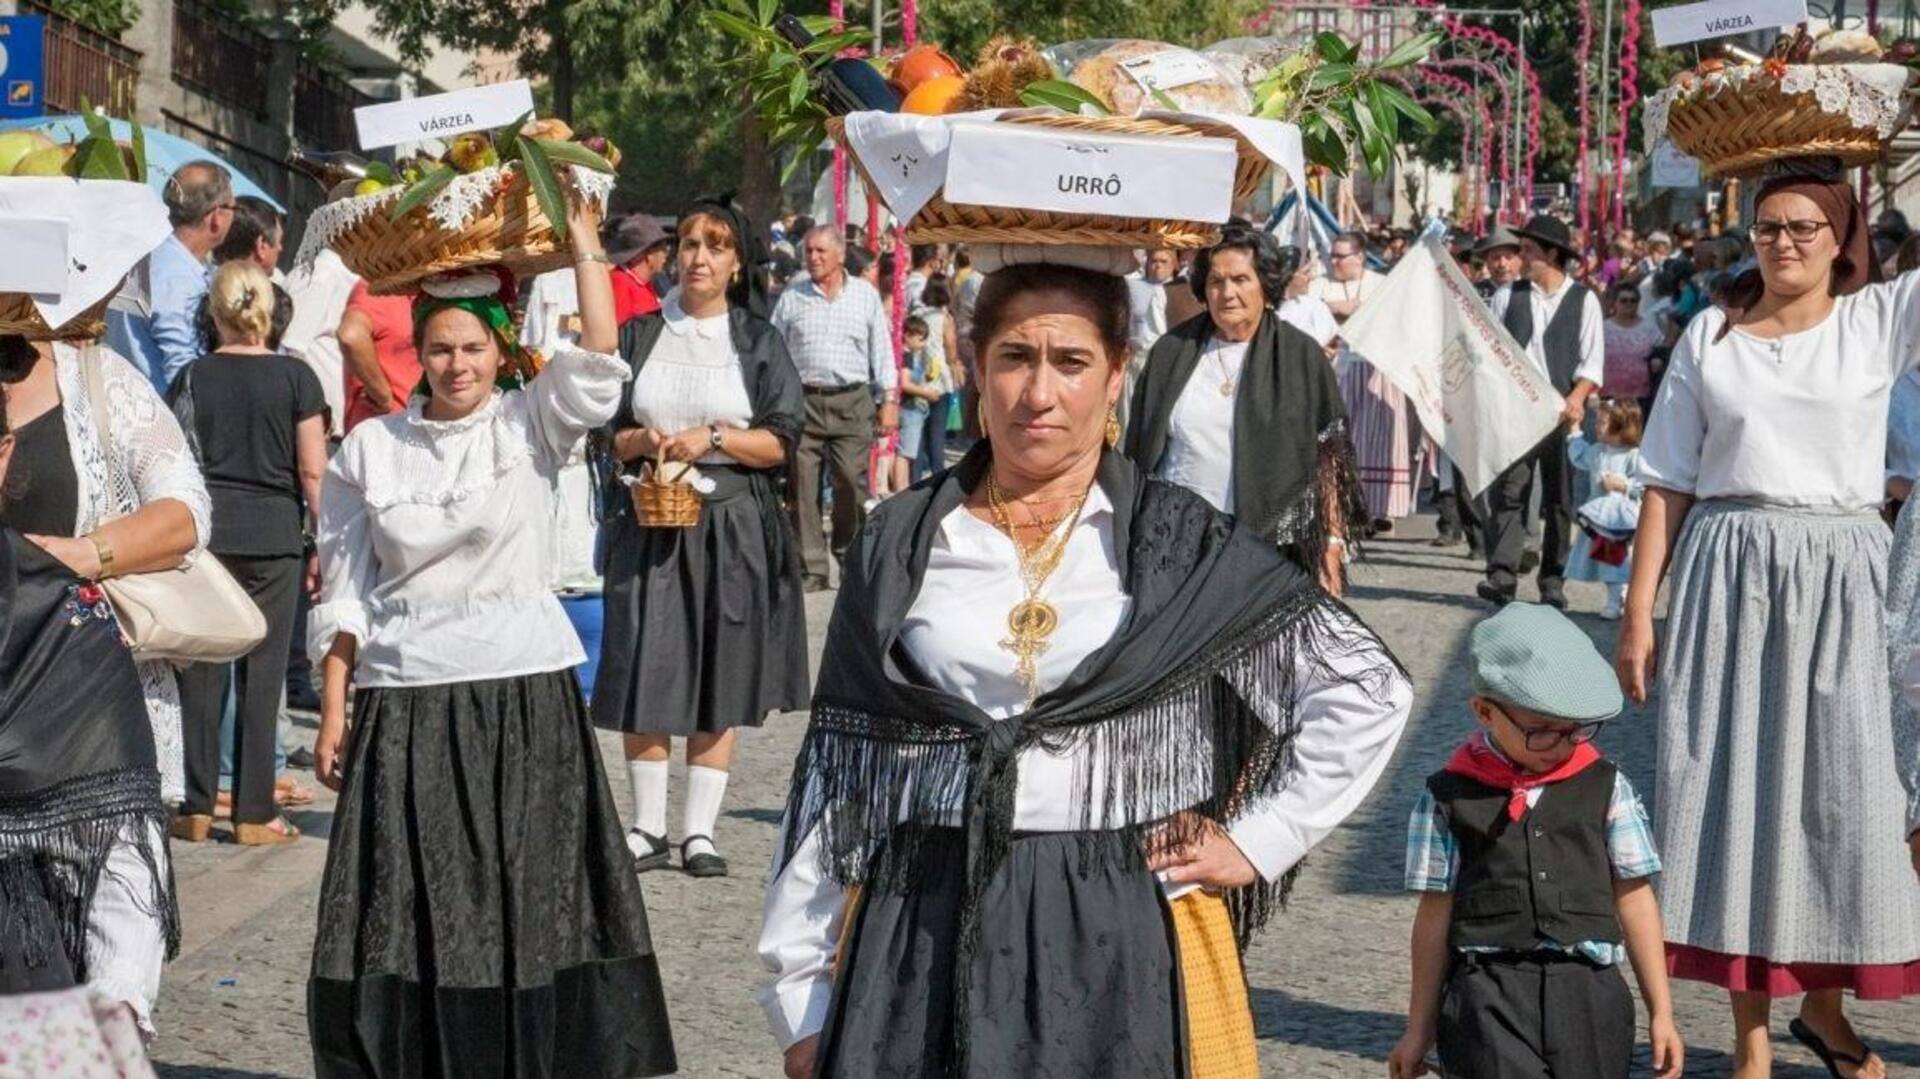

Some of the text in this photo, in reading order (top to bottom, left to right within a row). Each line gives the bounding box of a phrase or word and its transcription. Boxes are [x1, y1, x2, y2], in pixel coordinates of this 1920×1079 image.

[1704, 14, 1753, 32] VÁRZEA
[419, 113, 474, 132] VÁRZEA
[1058, 173, 1121, 196] URRÔ
[1490, 338, 1512, 368] Santa
[1510, 365, 1540, 402] Cristina
